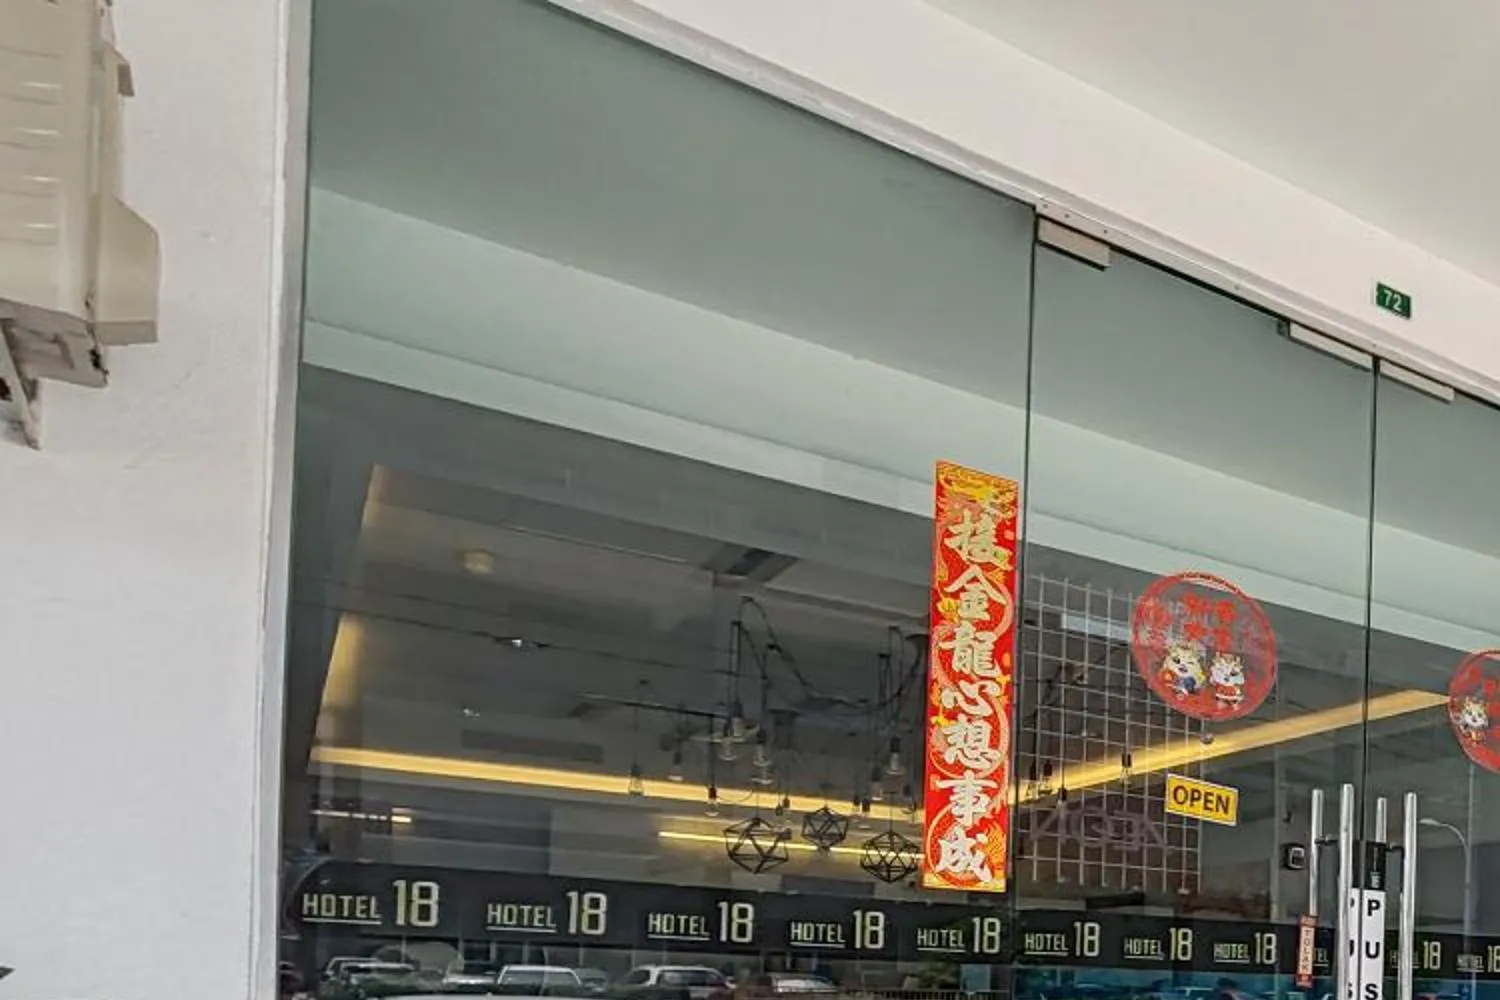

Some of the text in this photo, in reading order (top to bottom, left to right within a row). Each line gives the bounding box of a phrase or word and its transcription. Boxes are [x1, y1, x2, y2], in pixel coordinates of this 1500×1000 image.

[1383, 289, 1402, 312] 72
[1172, 785, 1231, 815] OPEN
[302, 879, 441, 929] HOTEL 18
[487, 890, 608, 936] HOTEL 18
[647, 900, 756, 944] HOTEL 18
[790, 909, 885, 949] HOTEL 18
[916, 916, 1001, 954] HOTEL 18
[1024, 921, 1100, 957] HOTEL 18
[1124, 927, 1193, 961] HOTEL 18
[1214, 932, 1277, 964] HOTEL 18
[1302, 929, 1312, 971] TOLAK
[1423, 941, 1441, 969] 18
